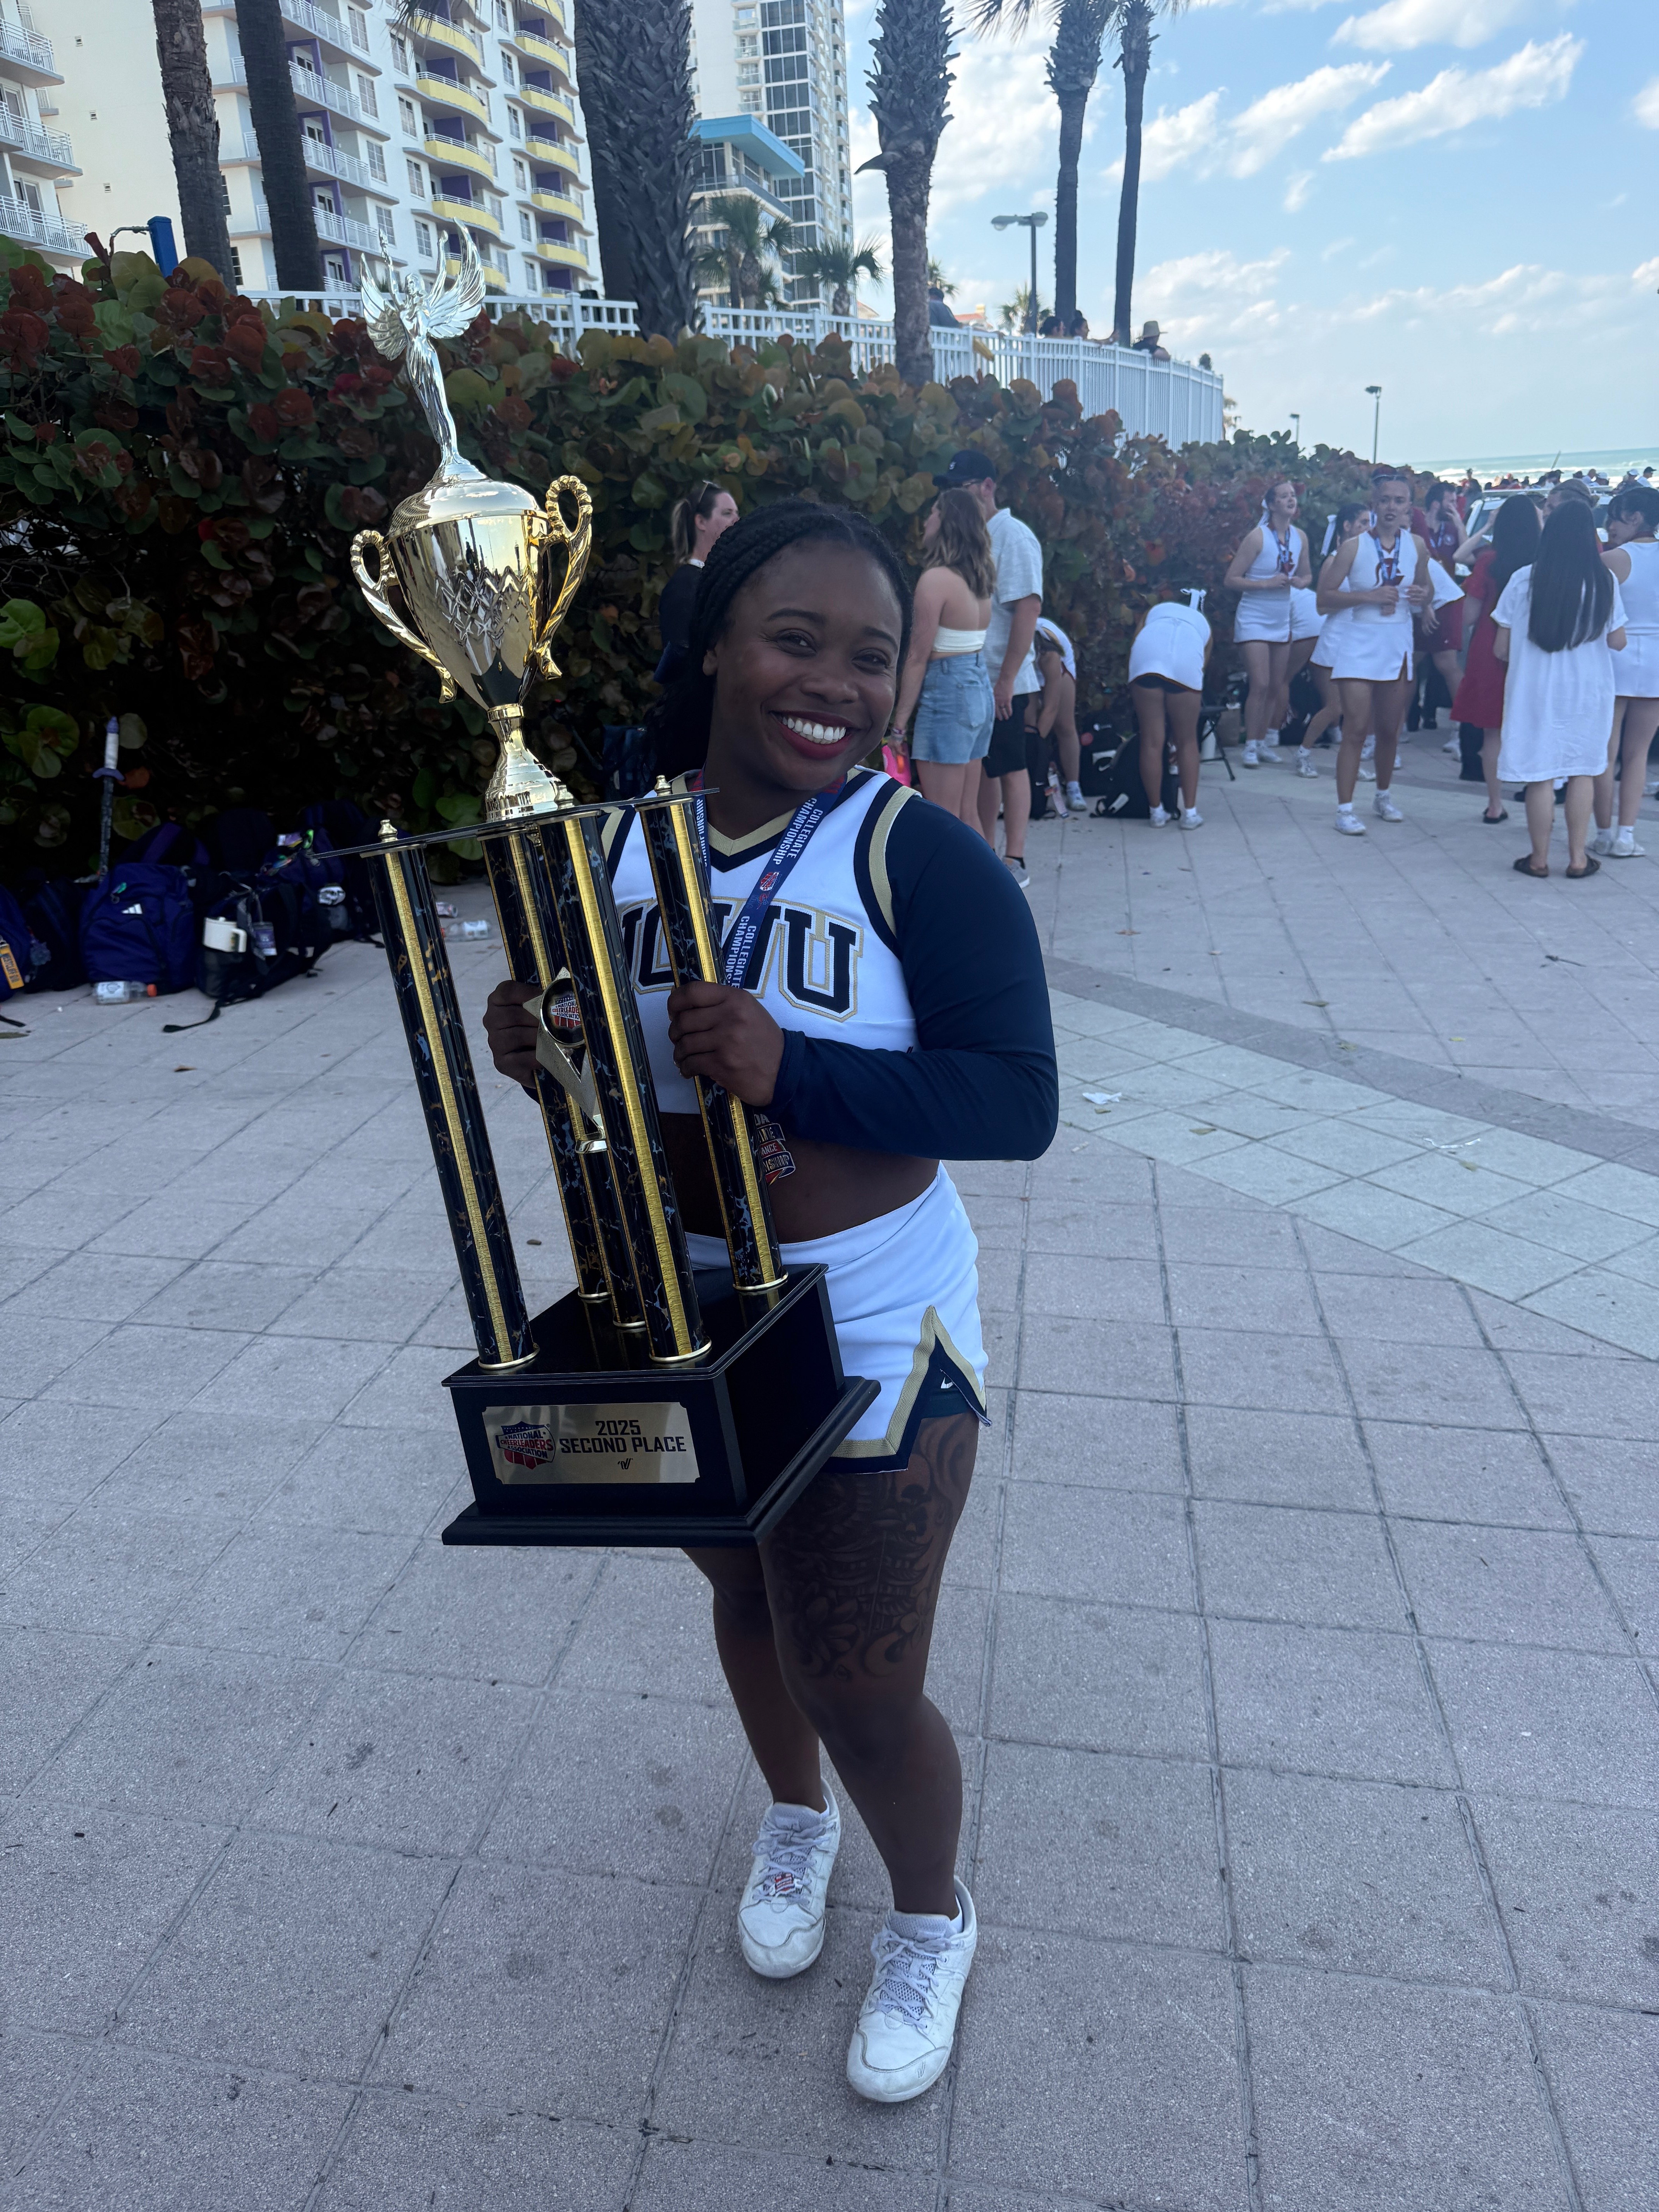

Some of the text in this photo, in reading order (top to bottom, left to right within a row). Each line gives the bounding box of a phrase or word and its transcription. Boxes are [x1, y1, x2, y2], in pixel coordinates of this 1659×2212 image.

[773, 798, 817, 865] CHAMPIONSHIP
[787, 809, 823, 859] COLLEGIATE
[508, 1430, 543, 1439] NATIONAL
[595, 1420, 641, 1435] 2025
[500, 1439, 554, 1451] CHEERLEADERS
[507, 1445, 548, 1459] ASSOCIATION
[559, 1436, 687, 1453] SECOND PLACE
